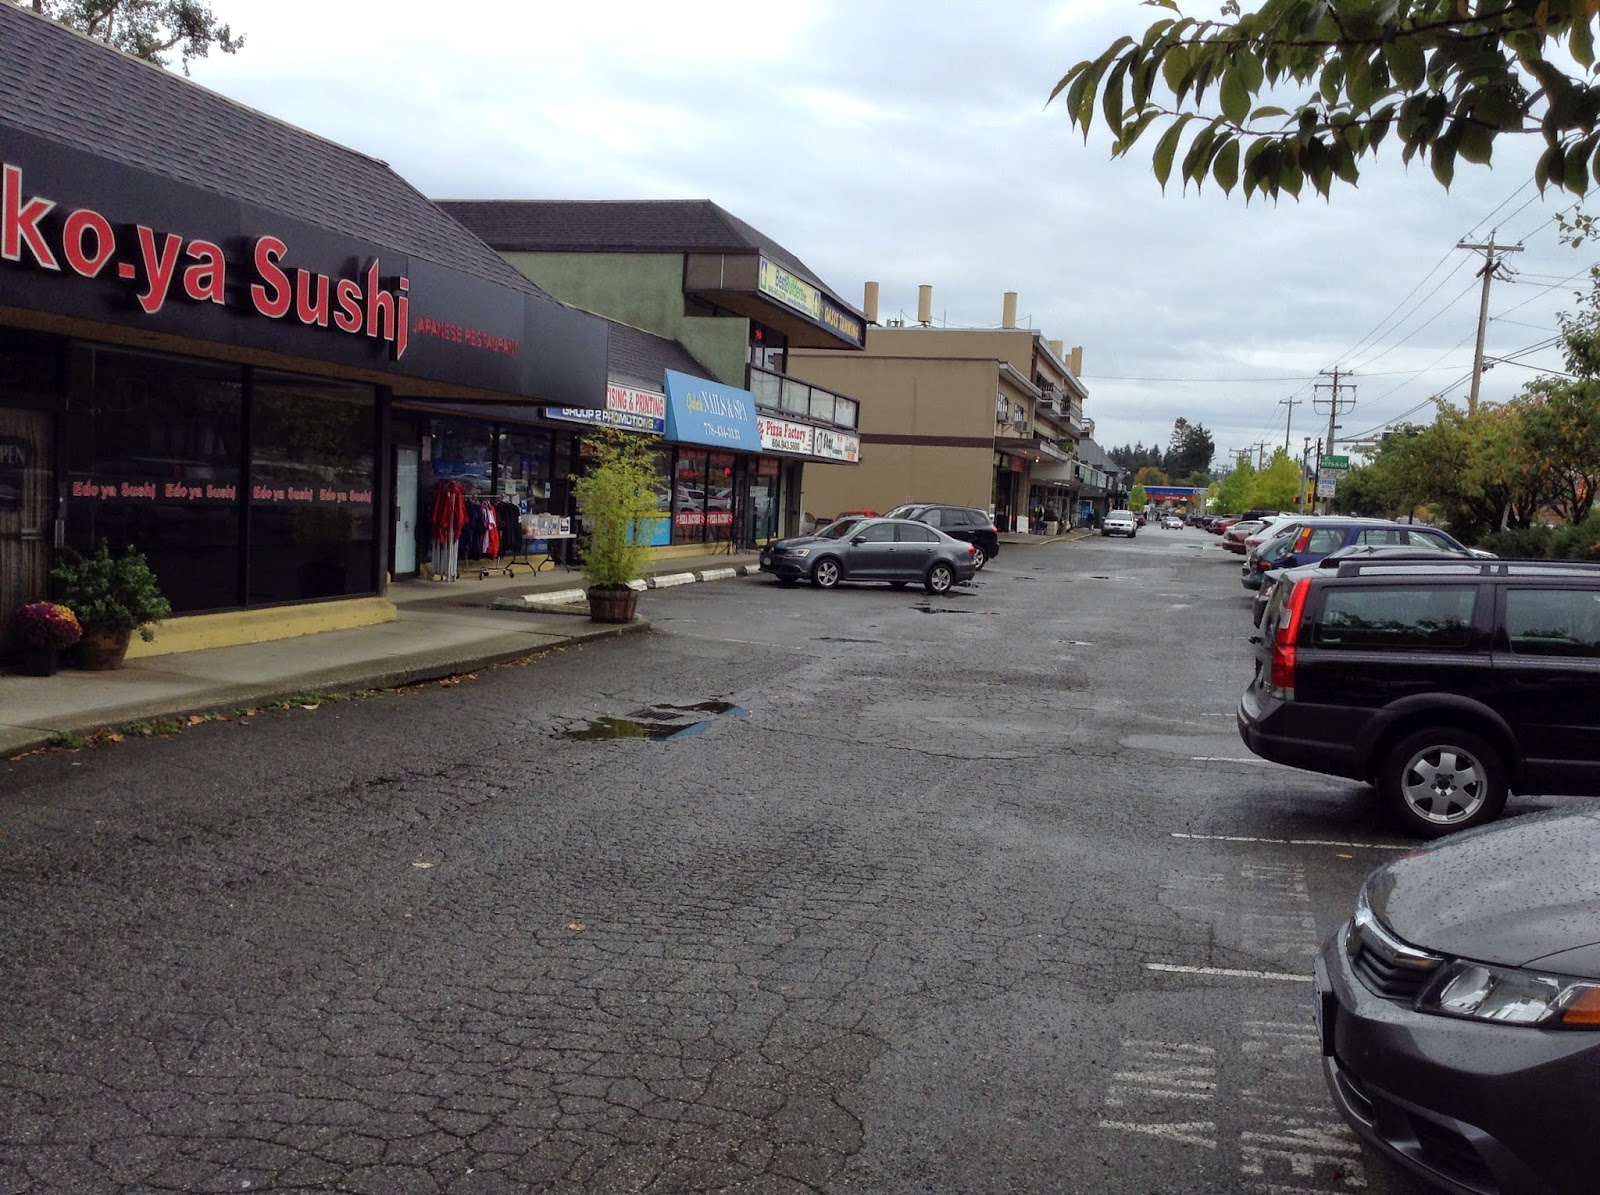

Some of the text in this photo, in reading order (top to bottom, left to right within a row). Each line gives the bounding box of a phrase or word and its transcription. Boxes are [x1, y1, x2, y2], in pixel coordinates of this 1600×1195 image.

[250, 235, 410, 361] Sushi
[412, 317, 521, 356] JAPANESE RESTAURANT
[607, 387, 664, 418] ISING & PRINTING
[701, 390, 727, 418] NAILS
[733, 399, 748, 421] SPA
[603, 410, 654, 430] PROMOTIONS
[766, 420, 782, 437] Pizza
[784, 423, 807, 444] Factory
